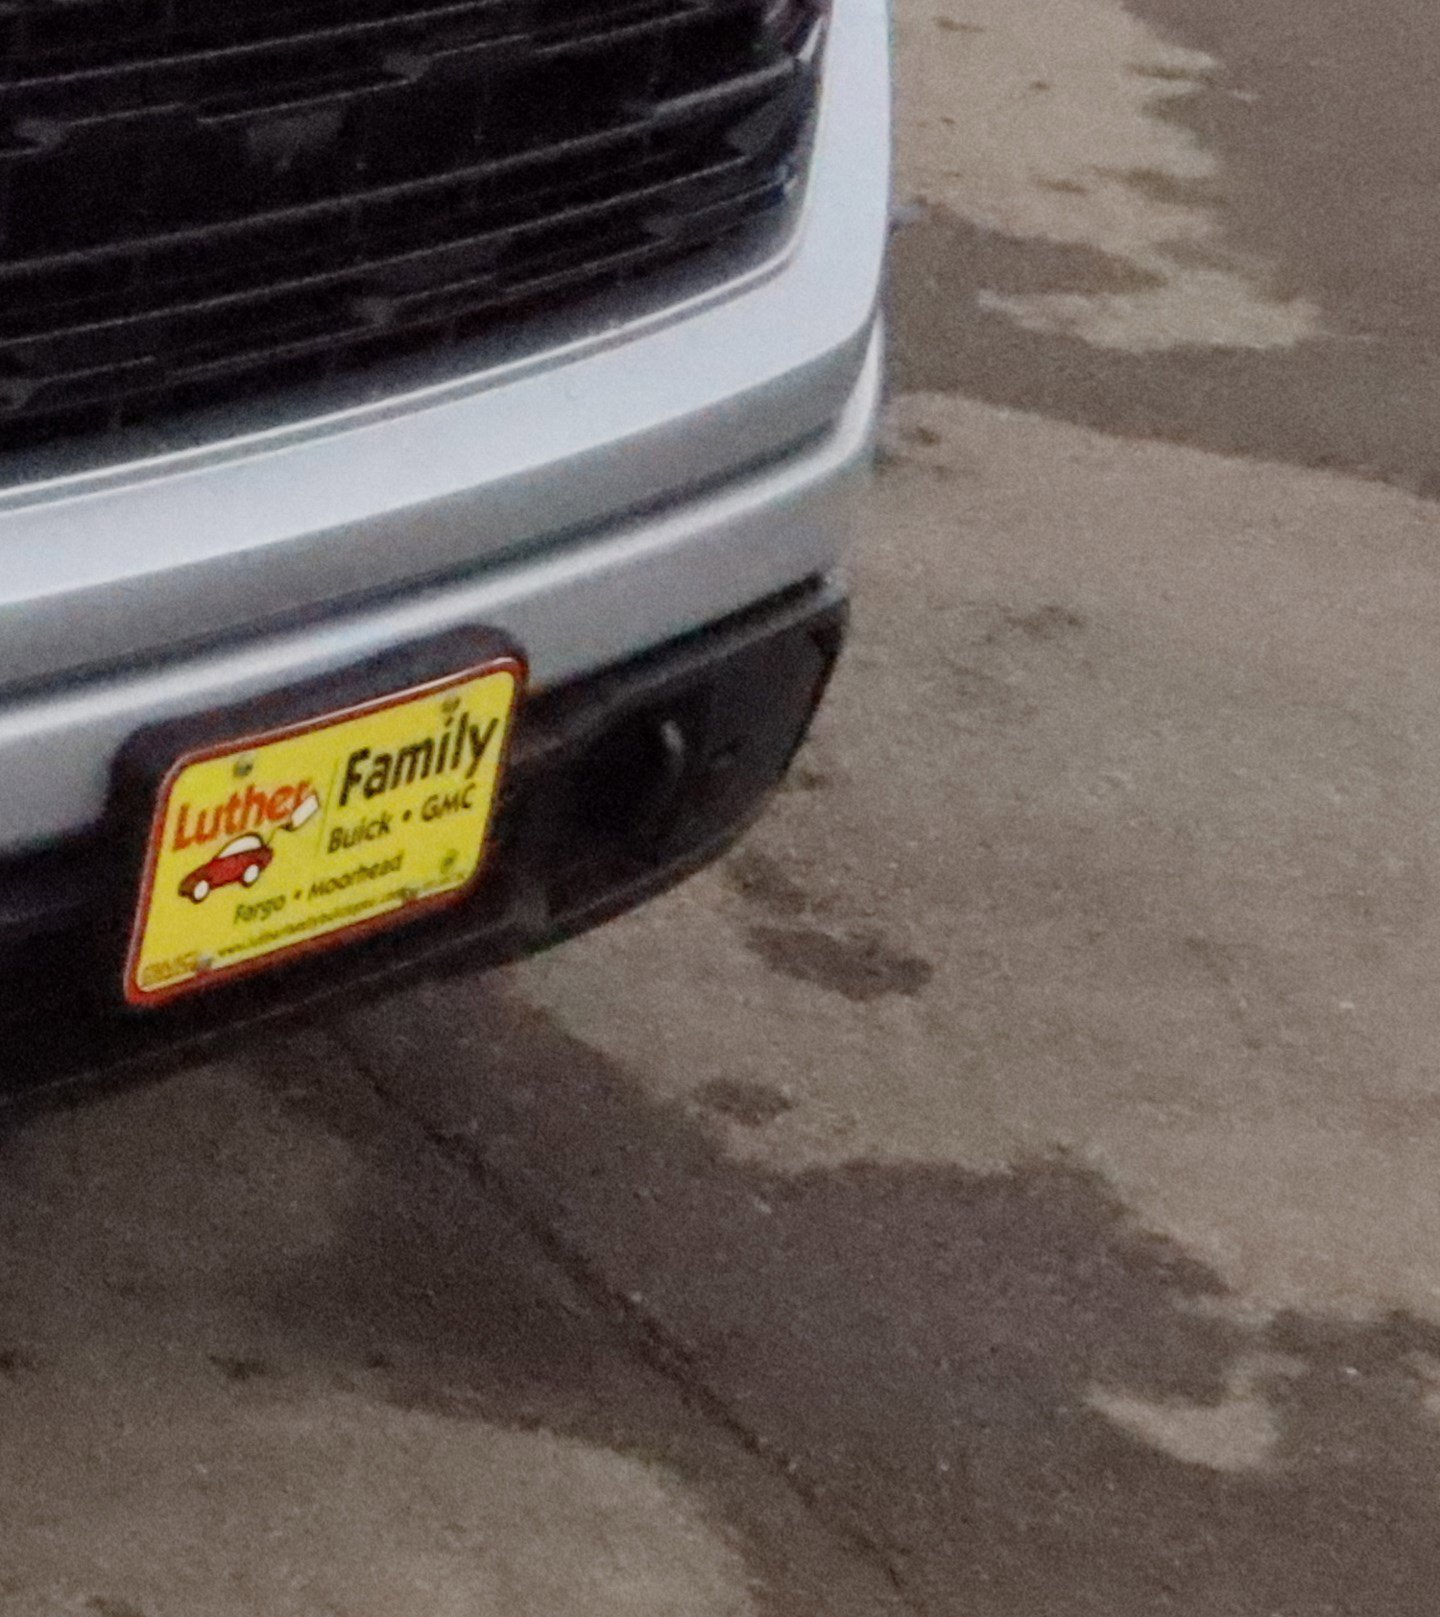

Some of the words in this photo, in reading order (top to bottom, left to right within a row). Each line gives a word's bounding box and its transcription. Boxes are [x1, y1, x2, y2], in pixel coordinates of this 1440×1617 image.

[338, 710, 500, 808] Family
[172, 778, 311, 853] Luther
[327, 812, 394, 855] Buick
[421, 783, 477, 822] GMC
